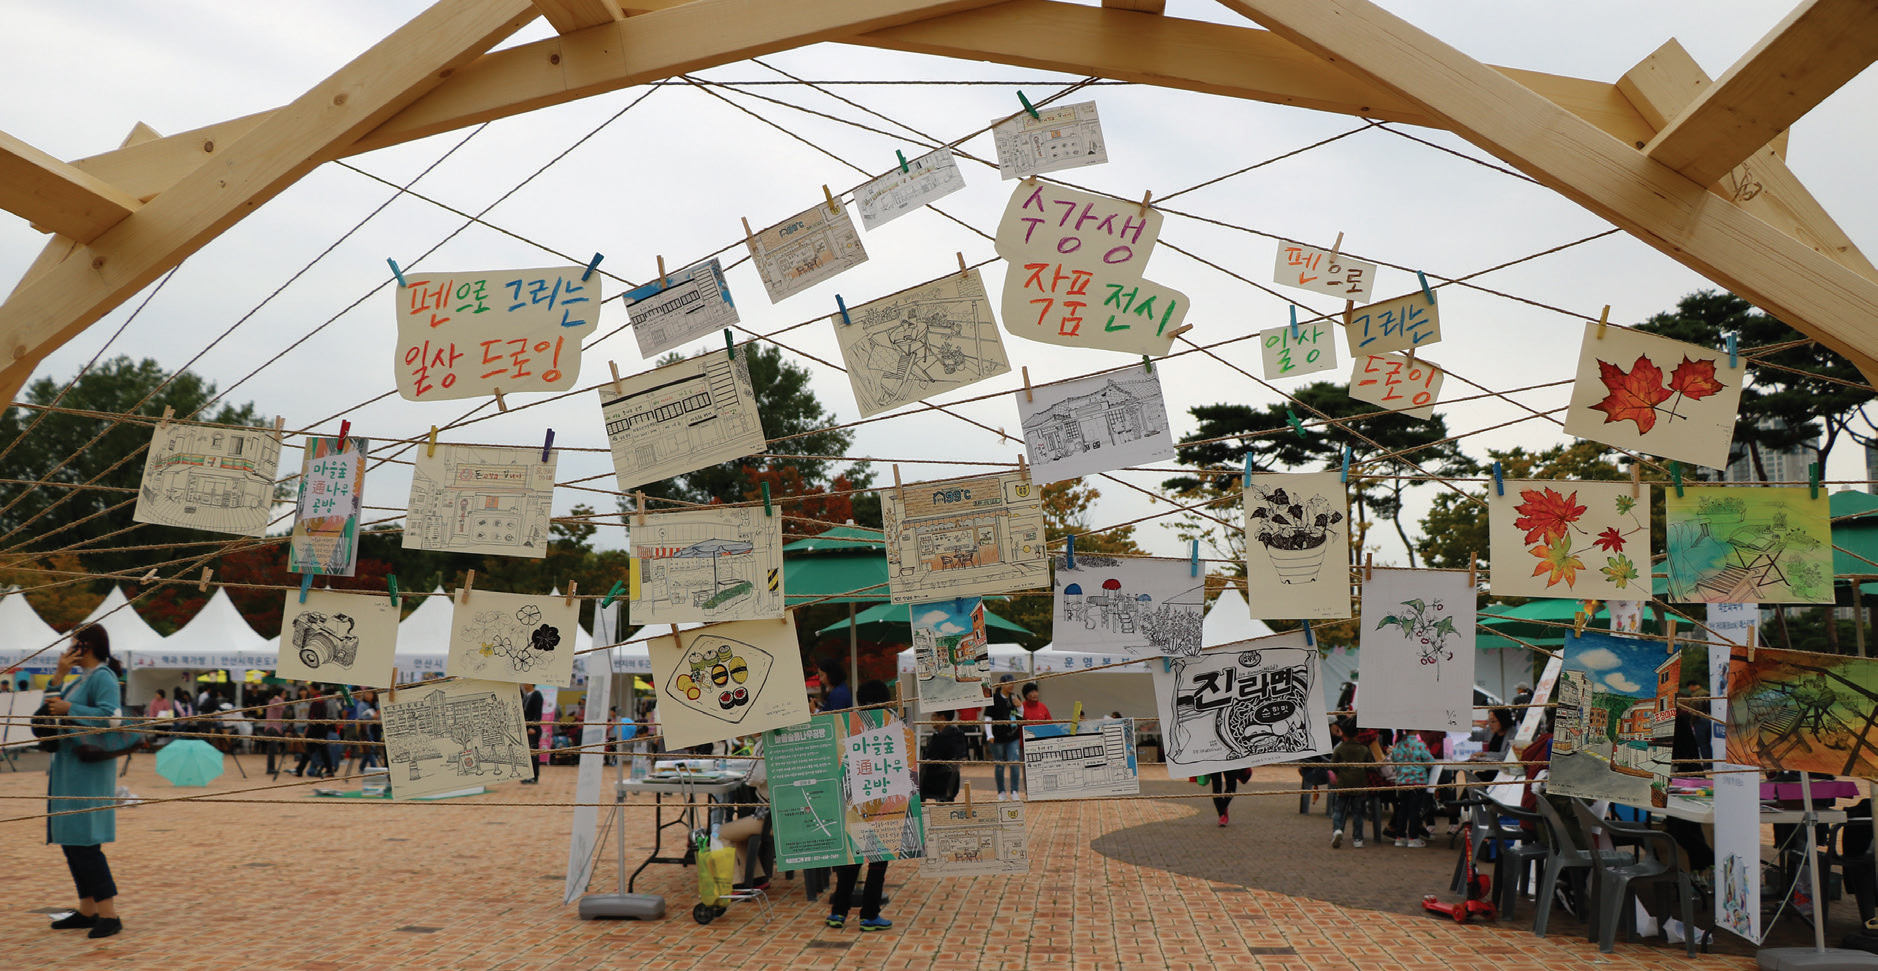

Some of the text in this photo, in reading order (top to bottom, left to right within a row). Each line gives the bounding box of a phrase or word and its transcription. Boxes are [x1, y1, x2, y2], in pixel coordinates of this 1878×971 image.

[1021, 186, 1146, 264] 수강생
[1285, 247, 1363, 294] 펜으로
[407, 276, 590, 328] 펜으로 그리는
[1024, 263, 1176, 337] 작품 전시
[1265, 325, 1324, 373] 일상
[1352, 304, 1434, 348] 그리는
[405, 335, 565, 397] 일상 드로잉
[1358, 355, 1436, 406] 드로잉
[313, 460, 347, 479] 마을숲
[312, 498, 335, 513] 공방
[1261, 705, 1290, 718] 순한맛
[853, 735, 895, 756] 마을숲
[862, 777, 891, 796] 공방
